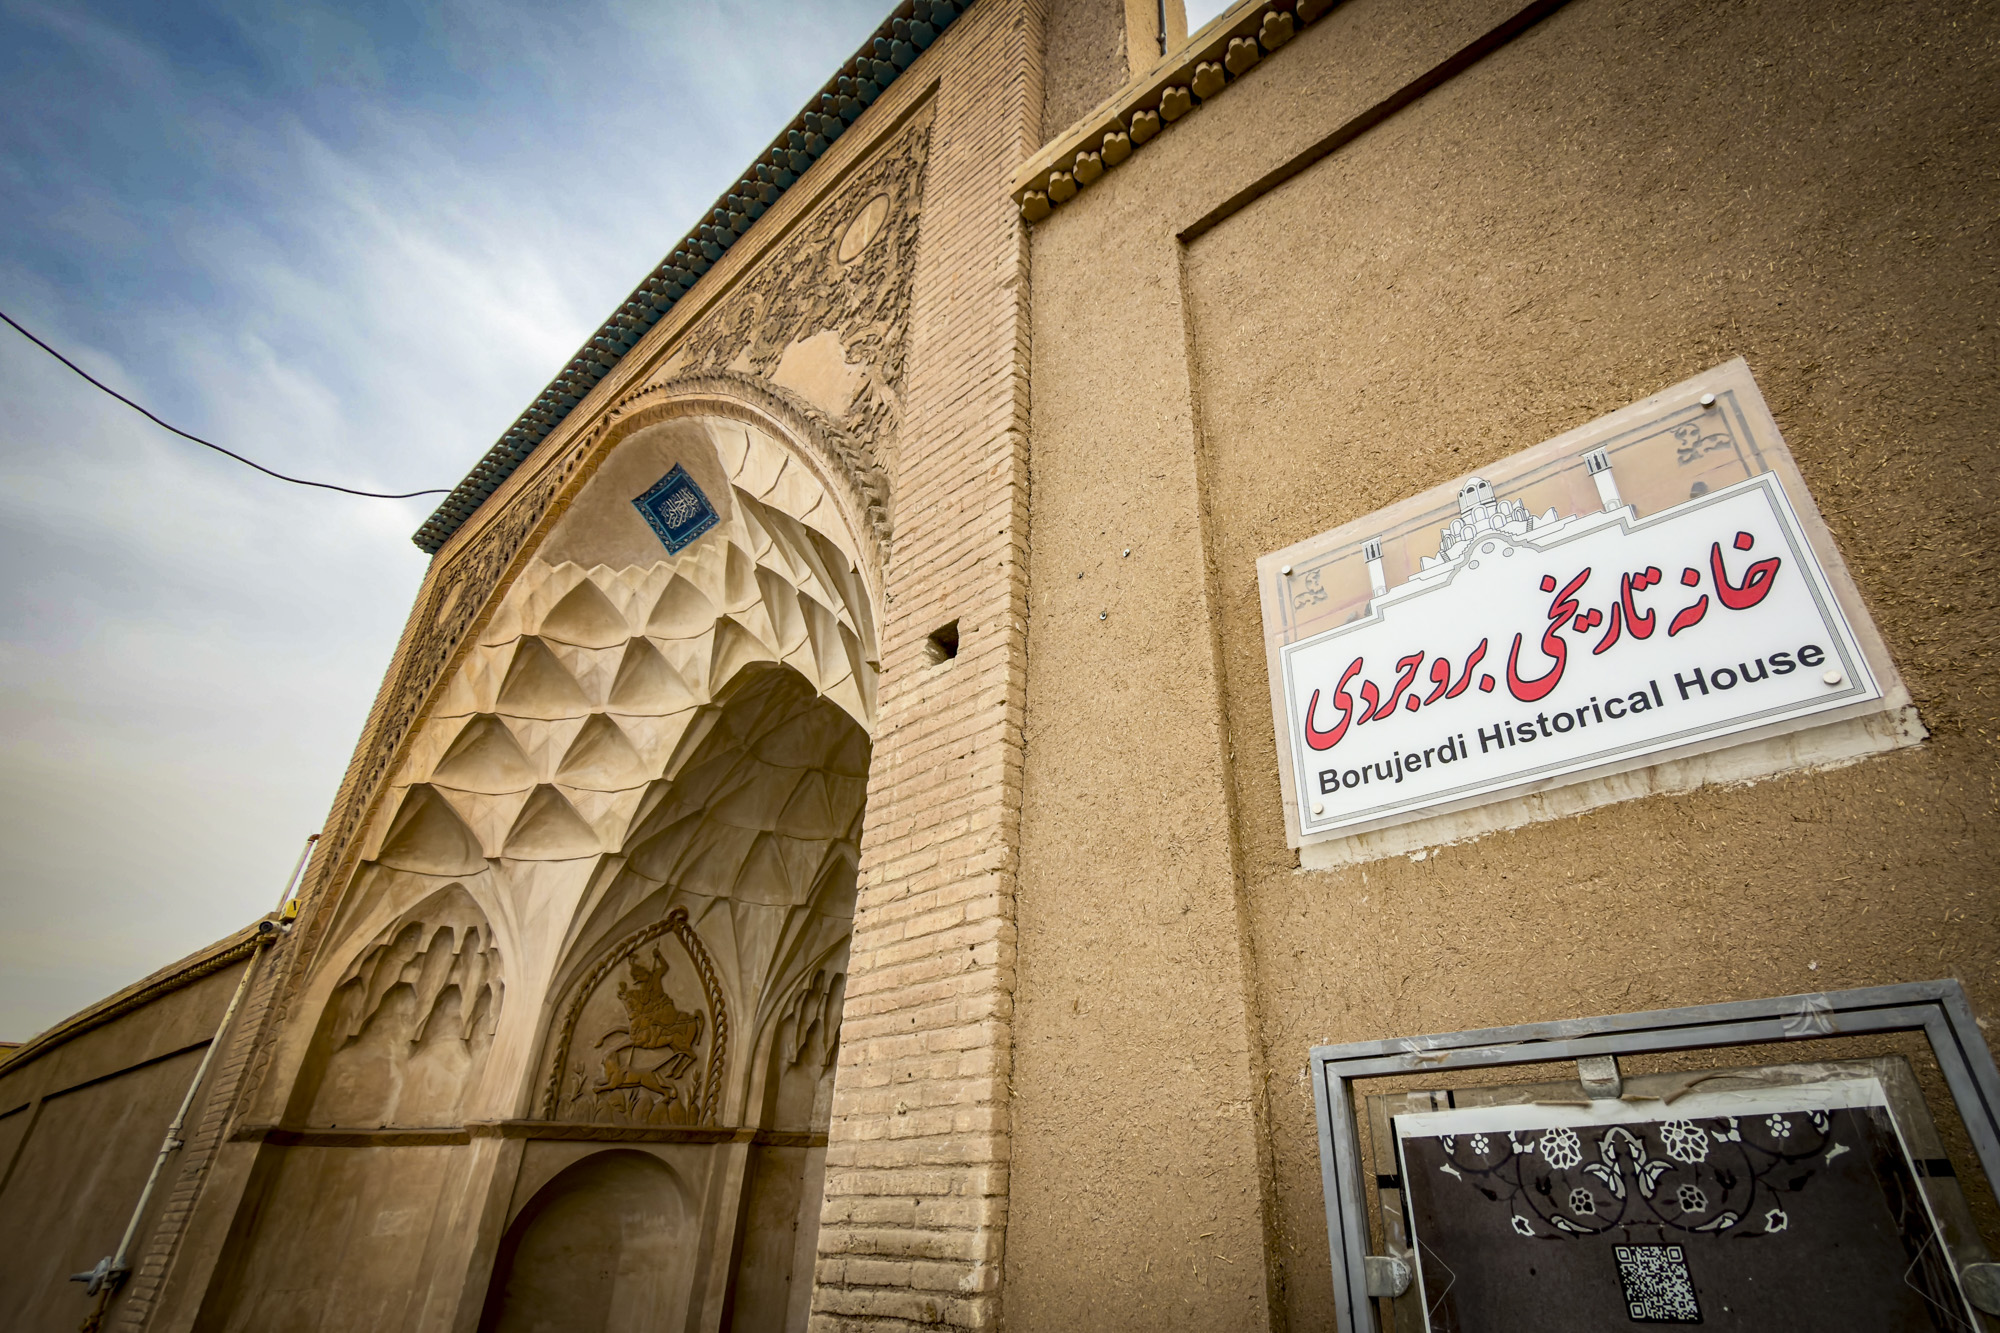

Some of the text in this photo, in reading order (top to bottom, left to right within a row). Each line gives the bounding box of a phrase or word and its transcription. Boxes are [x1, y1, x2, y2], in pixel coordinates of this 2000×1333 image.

[1305, 531, 1781, 751] خانه تاریخی بروجردی
[1318, 644, 1826, 795] Borujerdi Historical House
